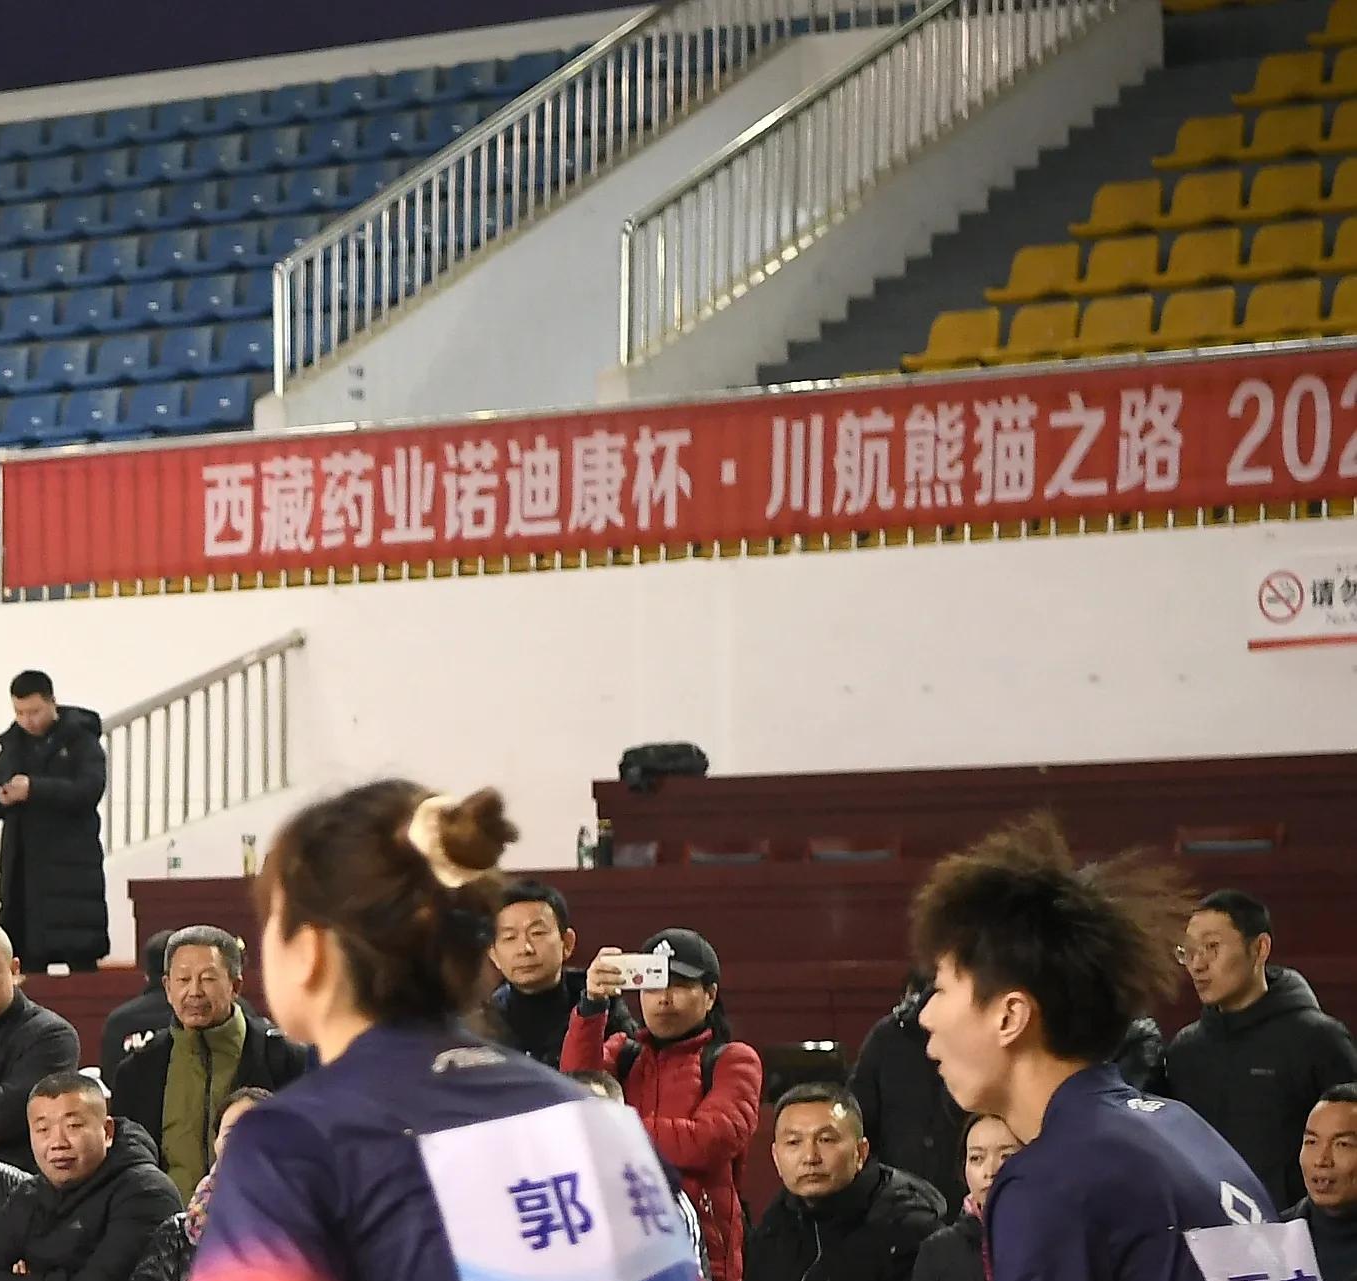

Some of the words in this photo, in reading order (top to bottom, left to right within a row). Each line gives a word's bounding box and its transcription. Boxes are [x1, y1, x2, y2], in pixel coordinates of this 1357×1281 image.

[202, 384, 1184, 557] 西藏药业诺迪康杯·川航熊猫之路
